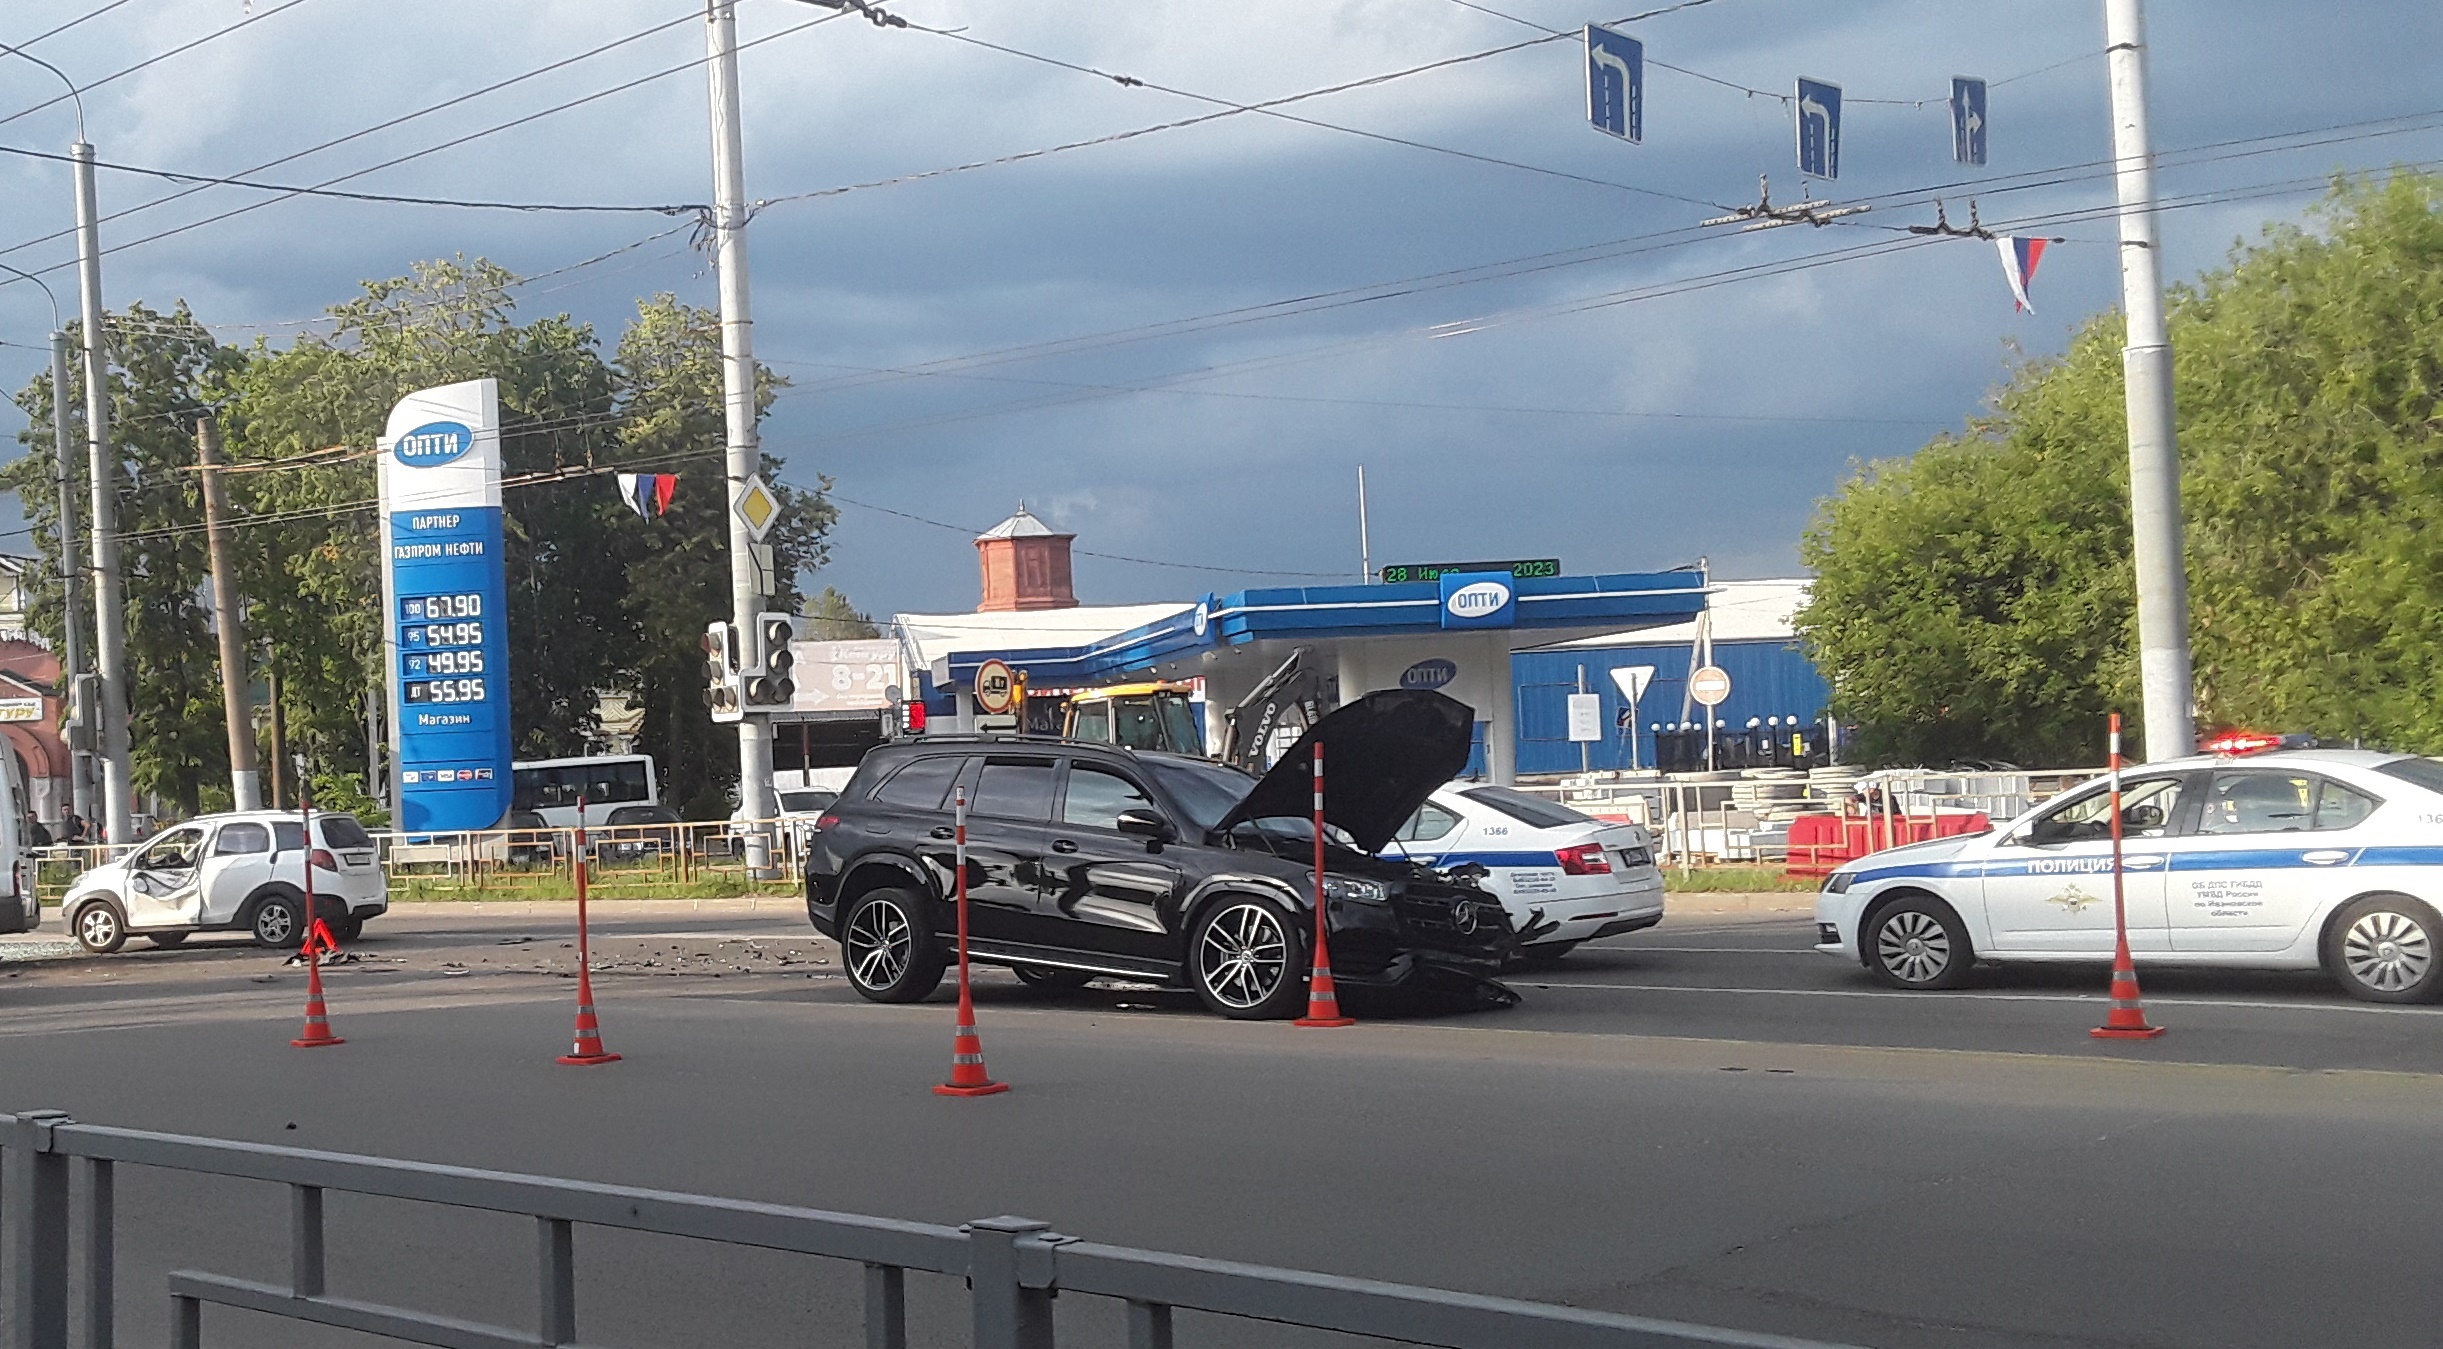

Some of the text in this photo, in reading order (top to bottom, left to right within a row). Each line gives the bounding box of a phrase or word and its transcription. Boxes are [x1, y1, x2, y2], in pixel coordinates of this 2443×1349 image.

[403, 432, 458, 457] ОПТИ
[412, 514, 460, 530] ПАРТНЕР
[394, 541, 484, 560] ГАЗПРОМ НЕФТИ
[1386, 567, 1407, 582] 28
[1513, 562, 1556, 577] 2023
[405, 594, 481, 618] 100 67.90
[1457, 591, 1500, 609] ОПТИ
[407, 622, 482, 647] 95 54.95
[408, 650, 483, 674] 92 49.95
[831, 664, 897, 692] 8-21
[1407, 667, 1448, 684] ОПТИ
[429, 678, 485, 702] 55.95
[418, 713, 471, 726] Магазин
[1247, 702, 1277, 758] VOLVO
